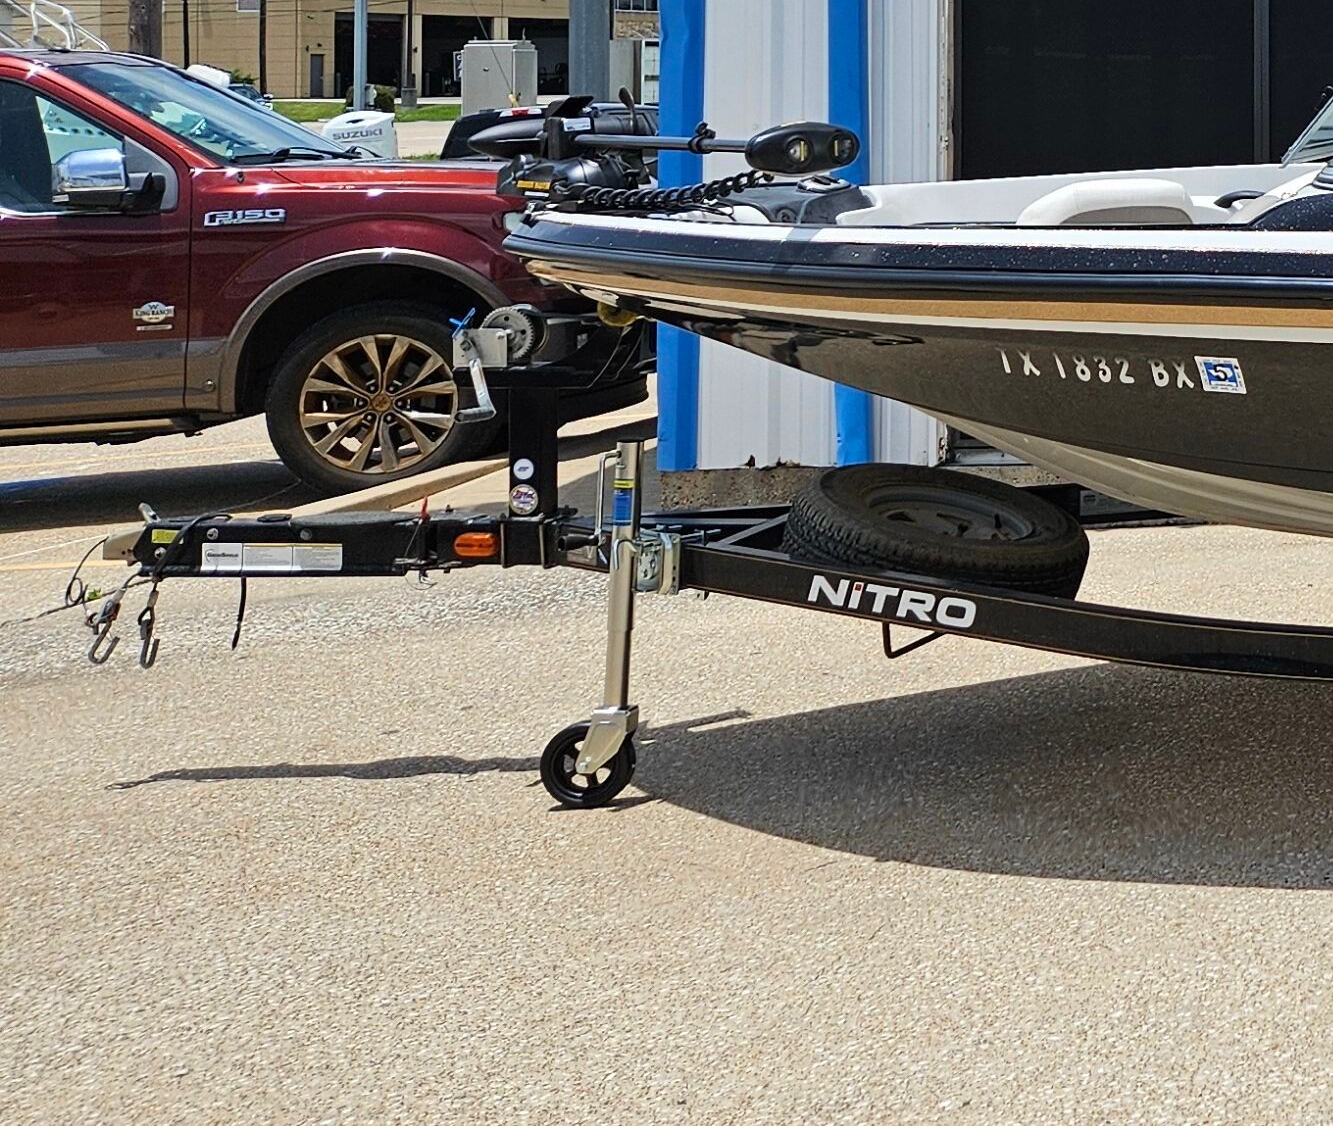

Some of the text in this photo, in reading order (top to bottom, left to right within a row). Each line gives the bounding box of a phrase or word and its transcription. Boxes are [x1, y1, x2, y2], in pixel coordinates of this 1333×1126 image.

[332, 128, 383, 140] SUZUKI
[1053, 351, 1135, 384] 1832
[1147, 358, 1195, 389] BX
